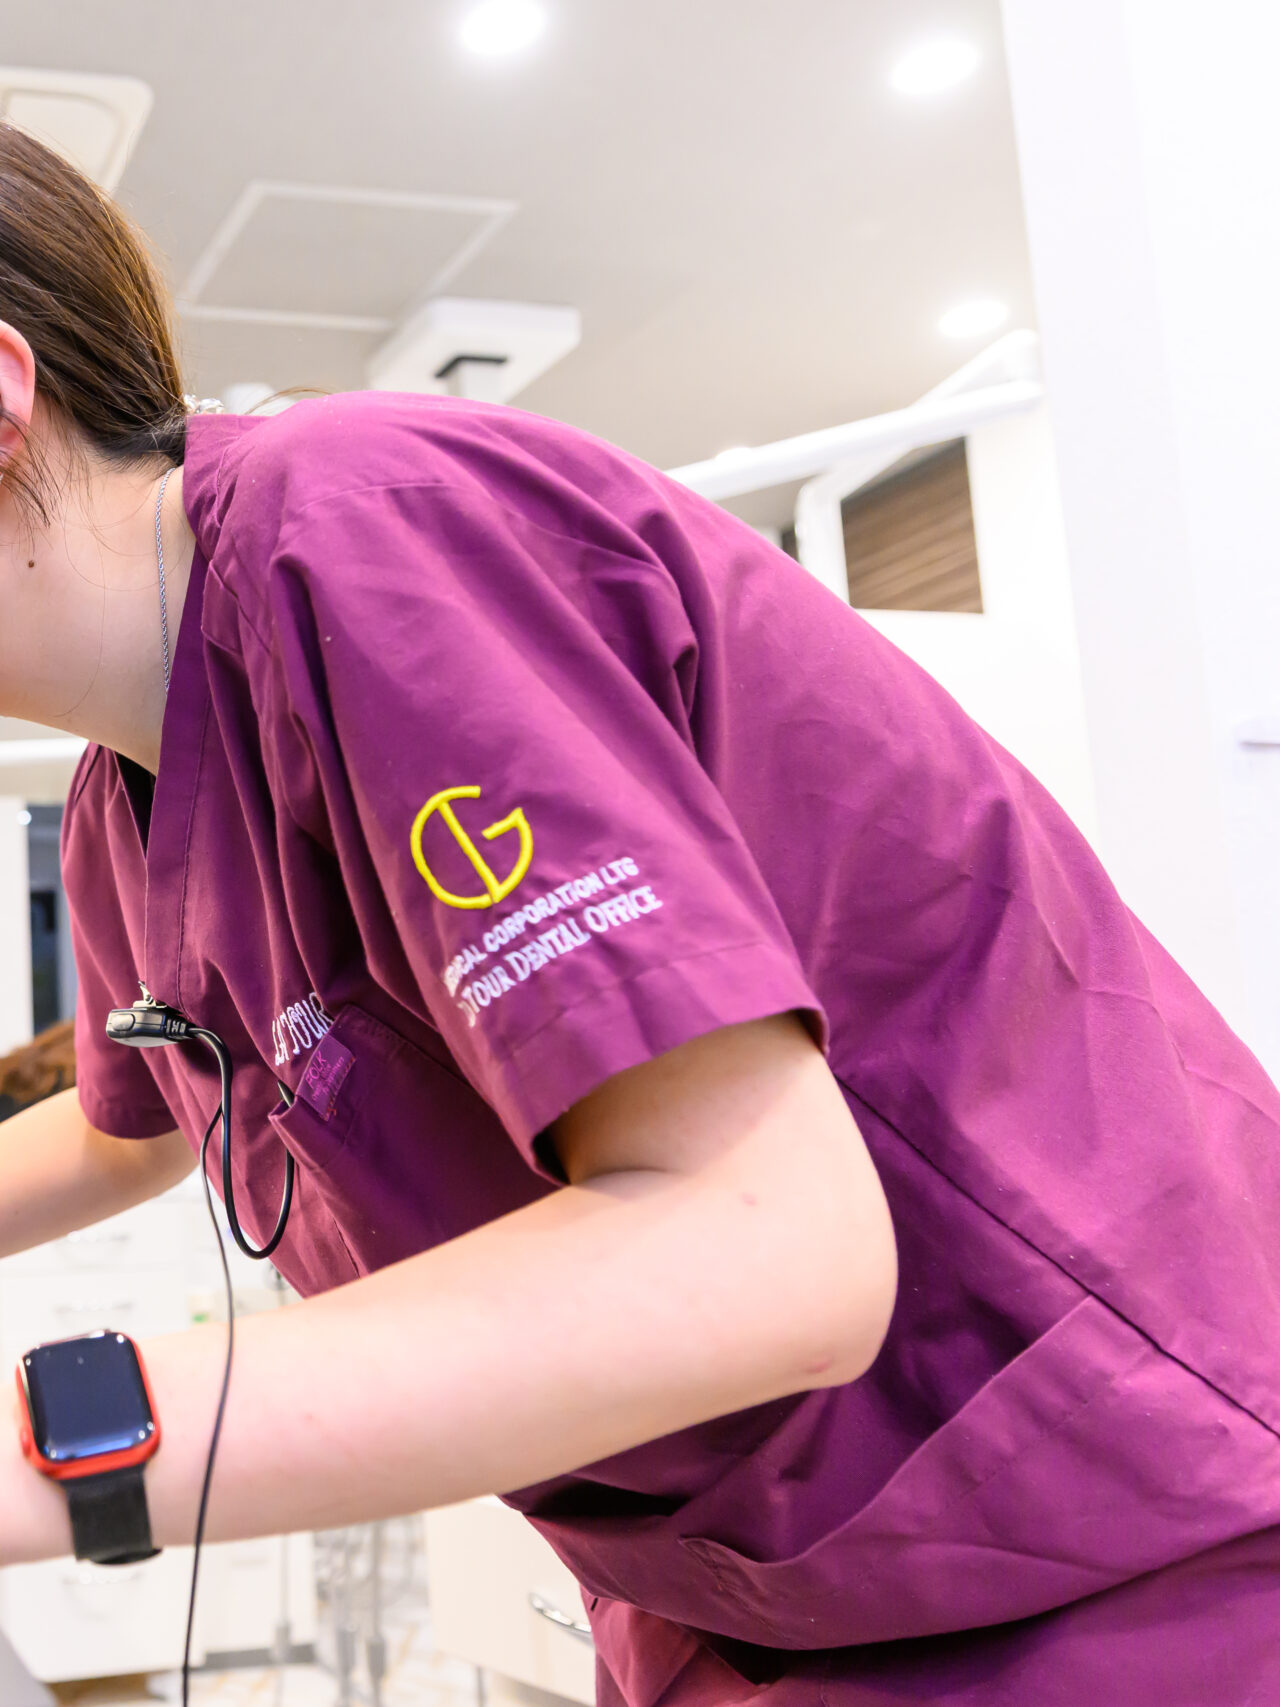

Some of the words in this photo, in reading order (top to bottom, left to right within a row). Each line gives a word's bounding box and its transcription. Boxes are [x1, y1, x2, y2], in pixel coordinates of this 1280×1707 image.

[483, 871, 605, 953] CORPORATION
[504, 917, 591, 982] DENTAL
[583, 885, 664, 933] OFFICE
